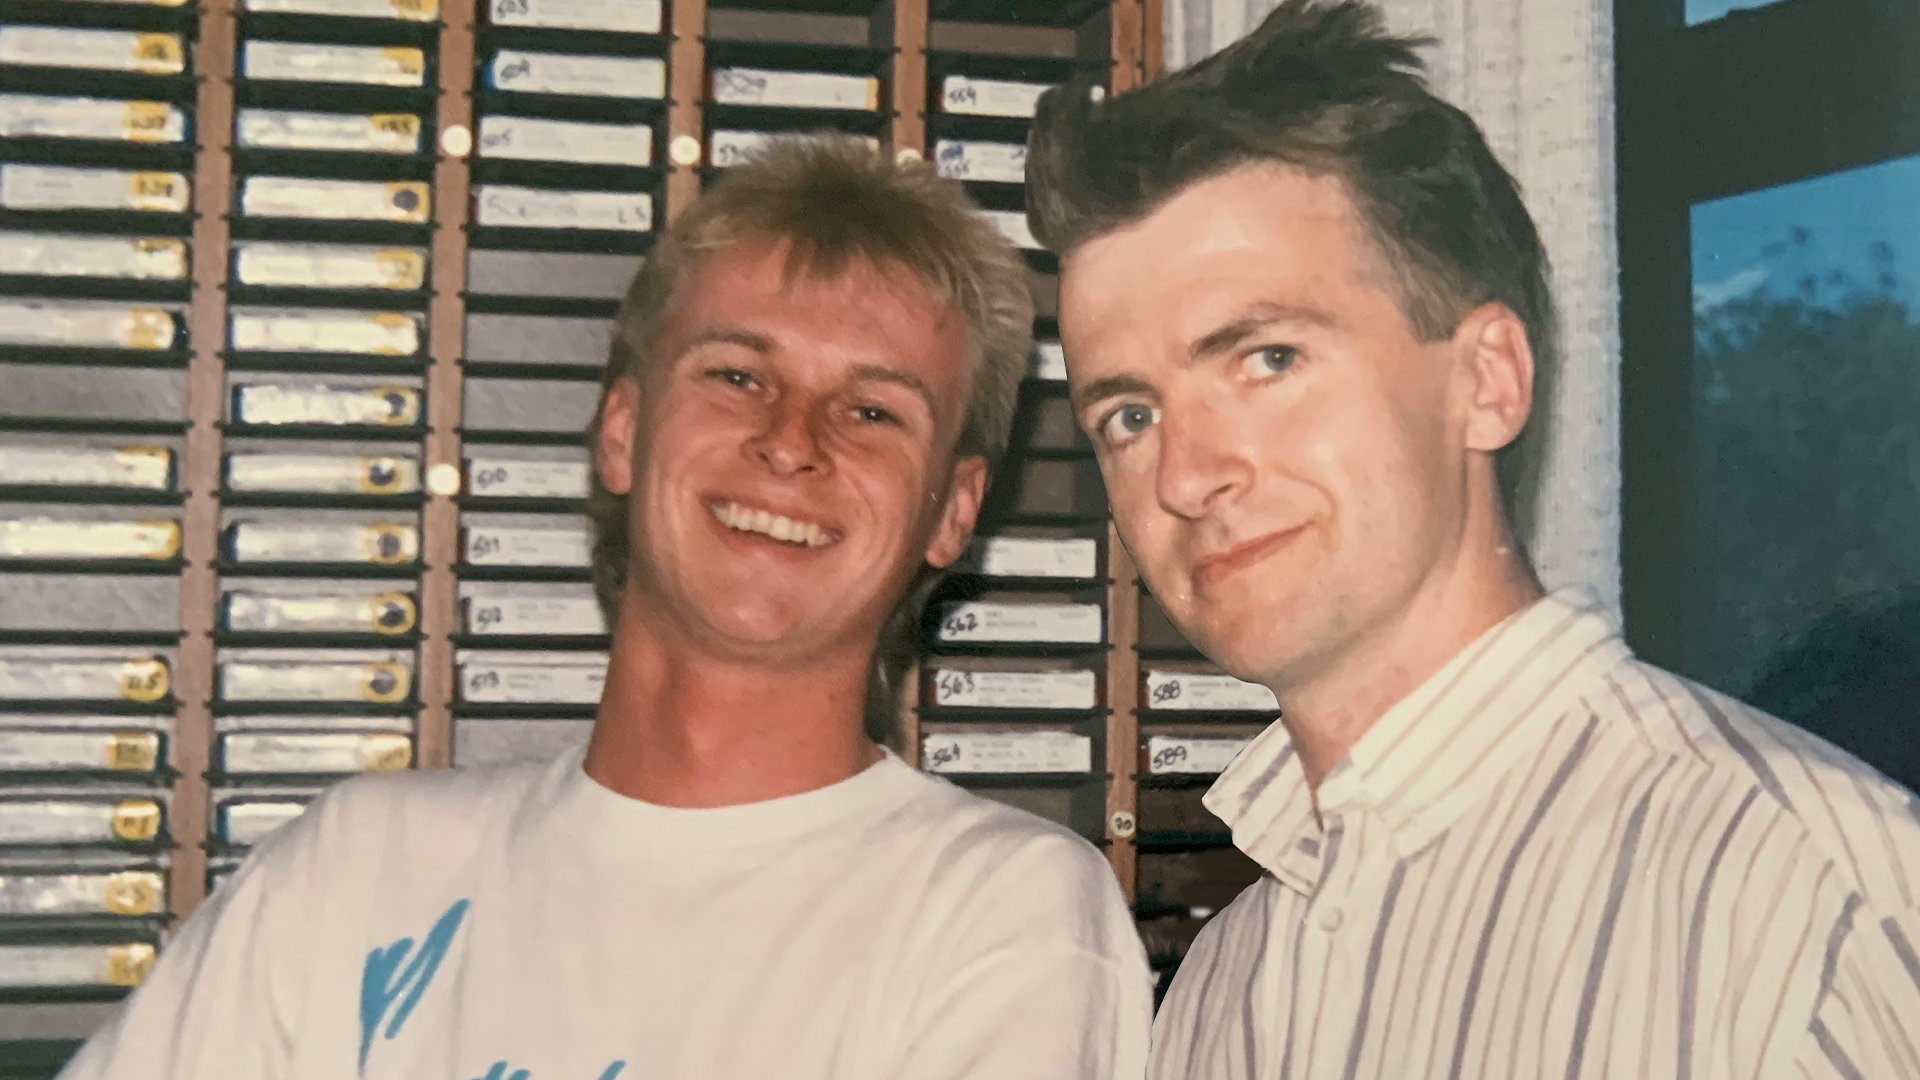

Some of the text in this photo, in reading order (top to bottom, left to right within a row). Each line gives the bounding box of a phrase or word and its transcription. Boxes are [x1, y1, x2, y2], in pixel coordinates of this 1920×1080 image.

[945, 612, 979, 637] 562
[940, 672, 976, 699] 563
[1152, 680, 1182, 703] 588
[933, 743, 961, 767] 564
[1152, 745, 1188, 770] 589
